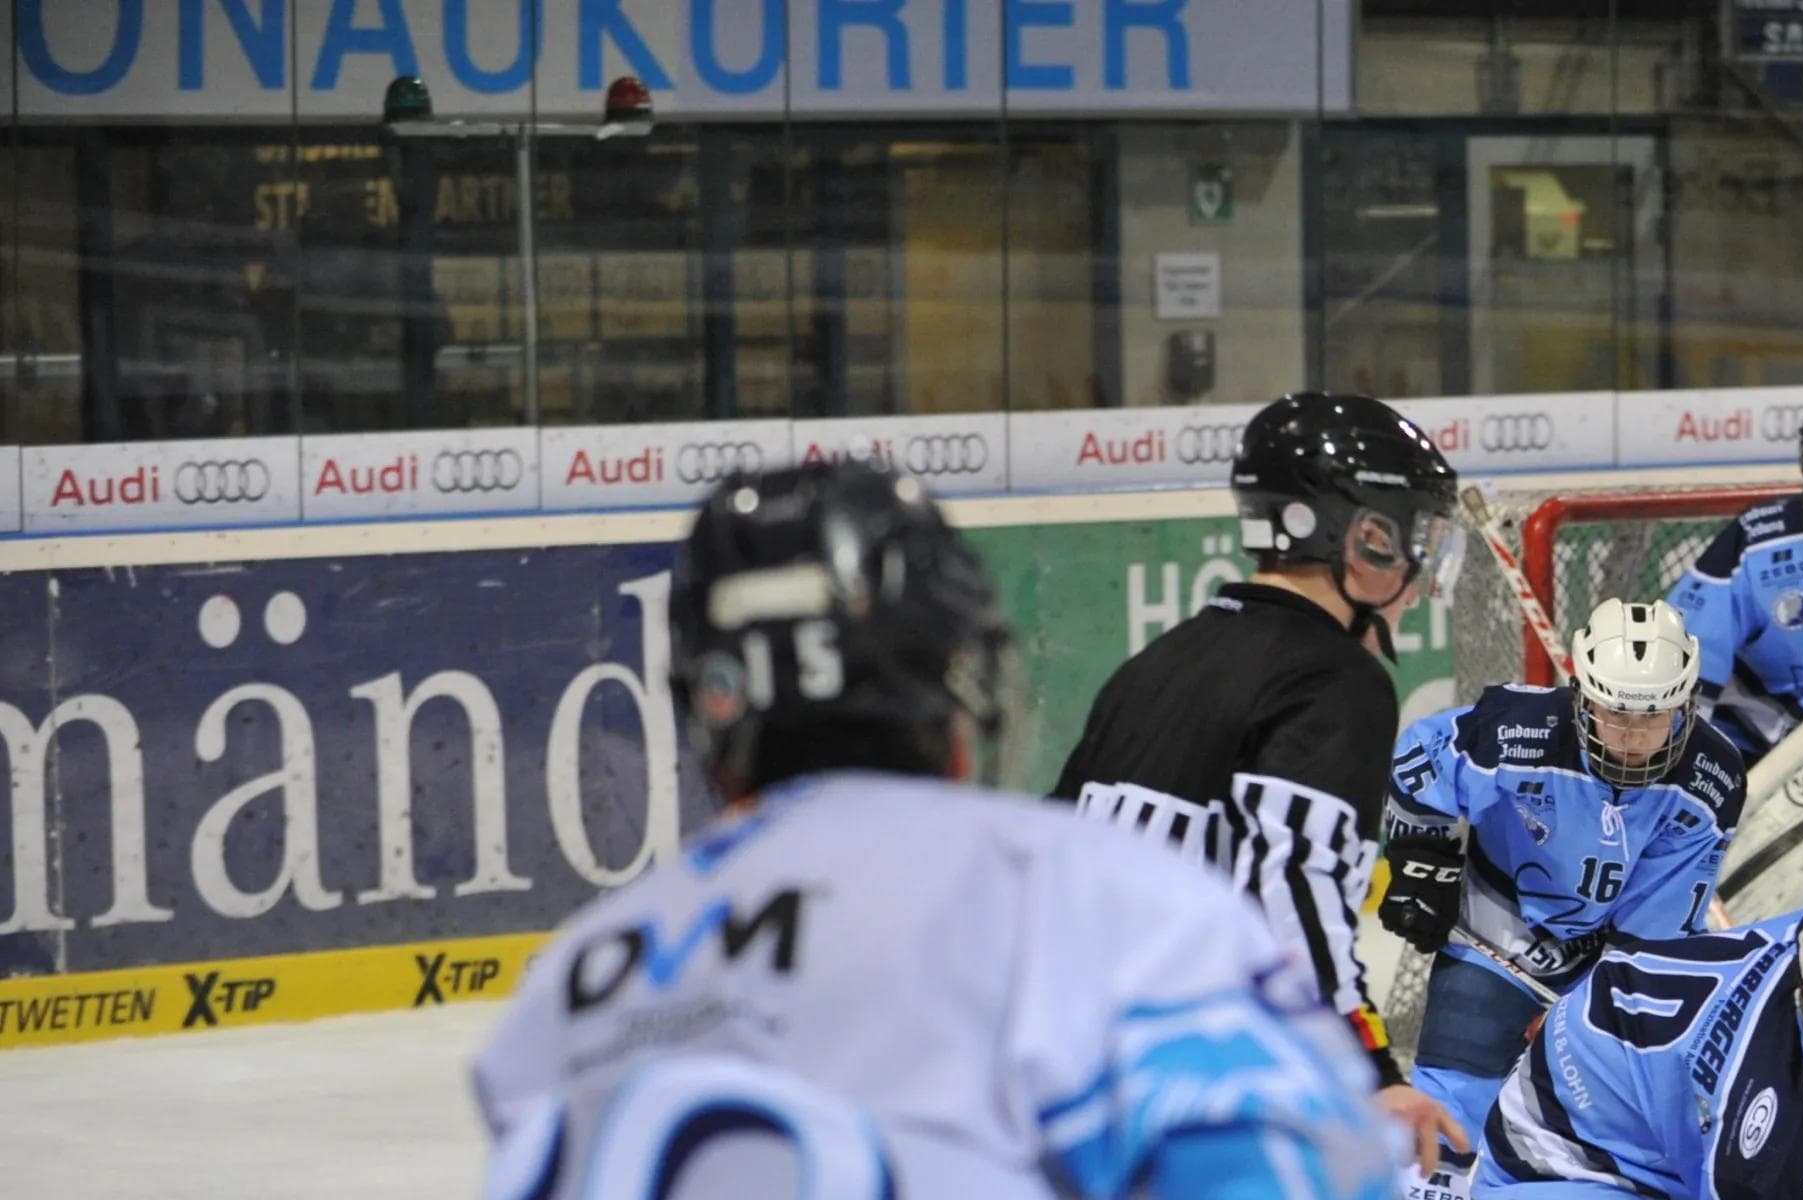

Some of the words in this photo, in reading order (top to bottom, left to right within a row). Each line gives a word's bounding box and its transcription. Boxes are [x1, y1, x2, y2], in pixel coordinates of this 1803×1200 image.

[1675, 409, 1752, 443] Audi
[566, 448, 665, 485] Audi
[1077, 431, 1167, 466] Audi
[50, 467, 160, 507] Audi
[315, 456, 418, 495] Audi
[1575, 856, 1624, 904] 16
[1559, 1053, 1593, 1110] LOHN
